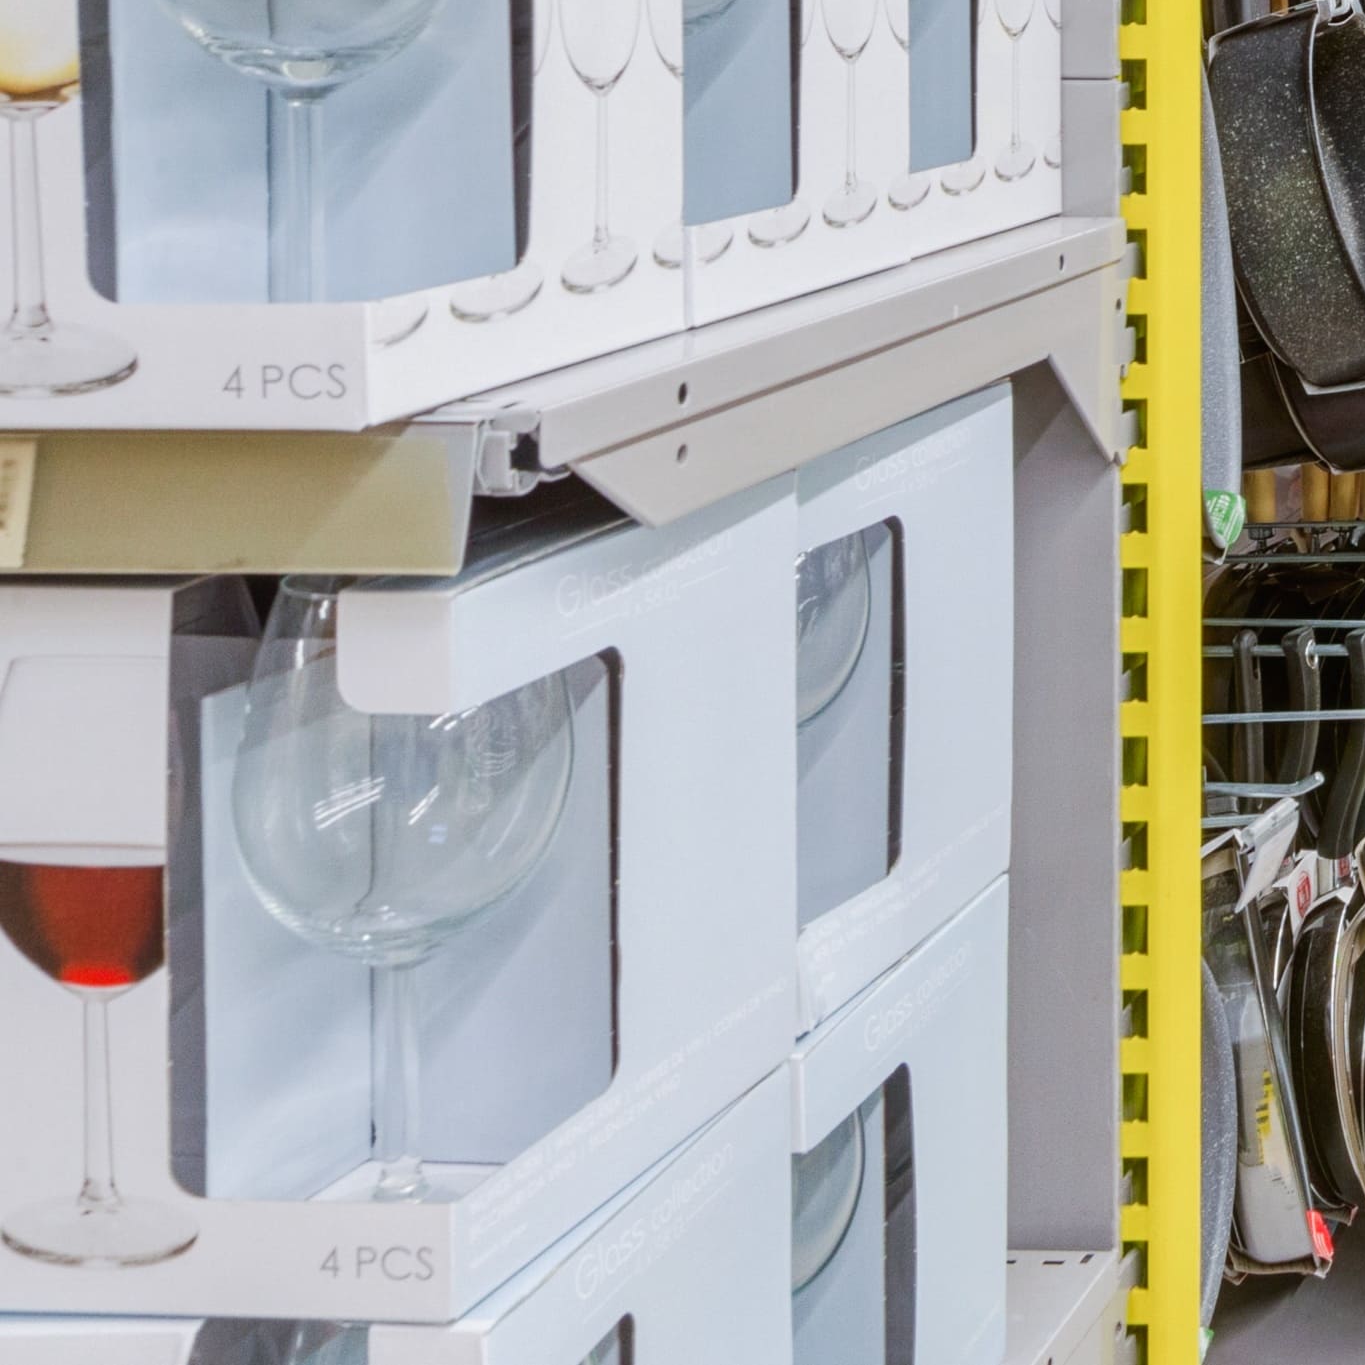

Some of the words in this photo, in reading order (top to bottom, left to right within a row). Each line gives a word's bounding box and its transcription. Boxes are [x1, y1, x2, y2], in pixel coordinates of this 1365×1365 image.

[223, 364, 245, 400] 4
[262, 363, 348, 401] PCS
[318, 1245, 343, 1280] 4
[354, 1245, 435, 1284] PCS
